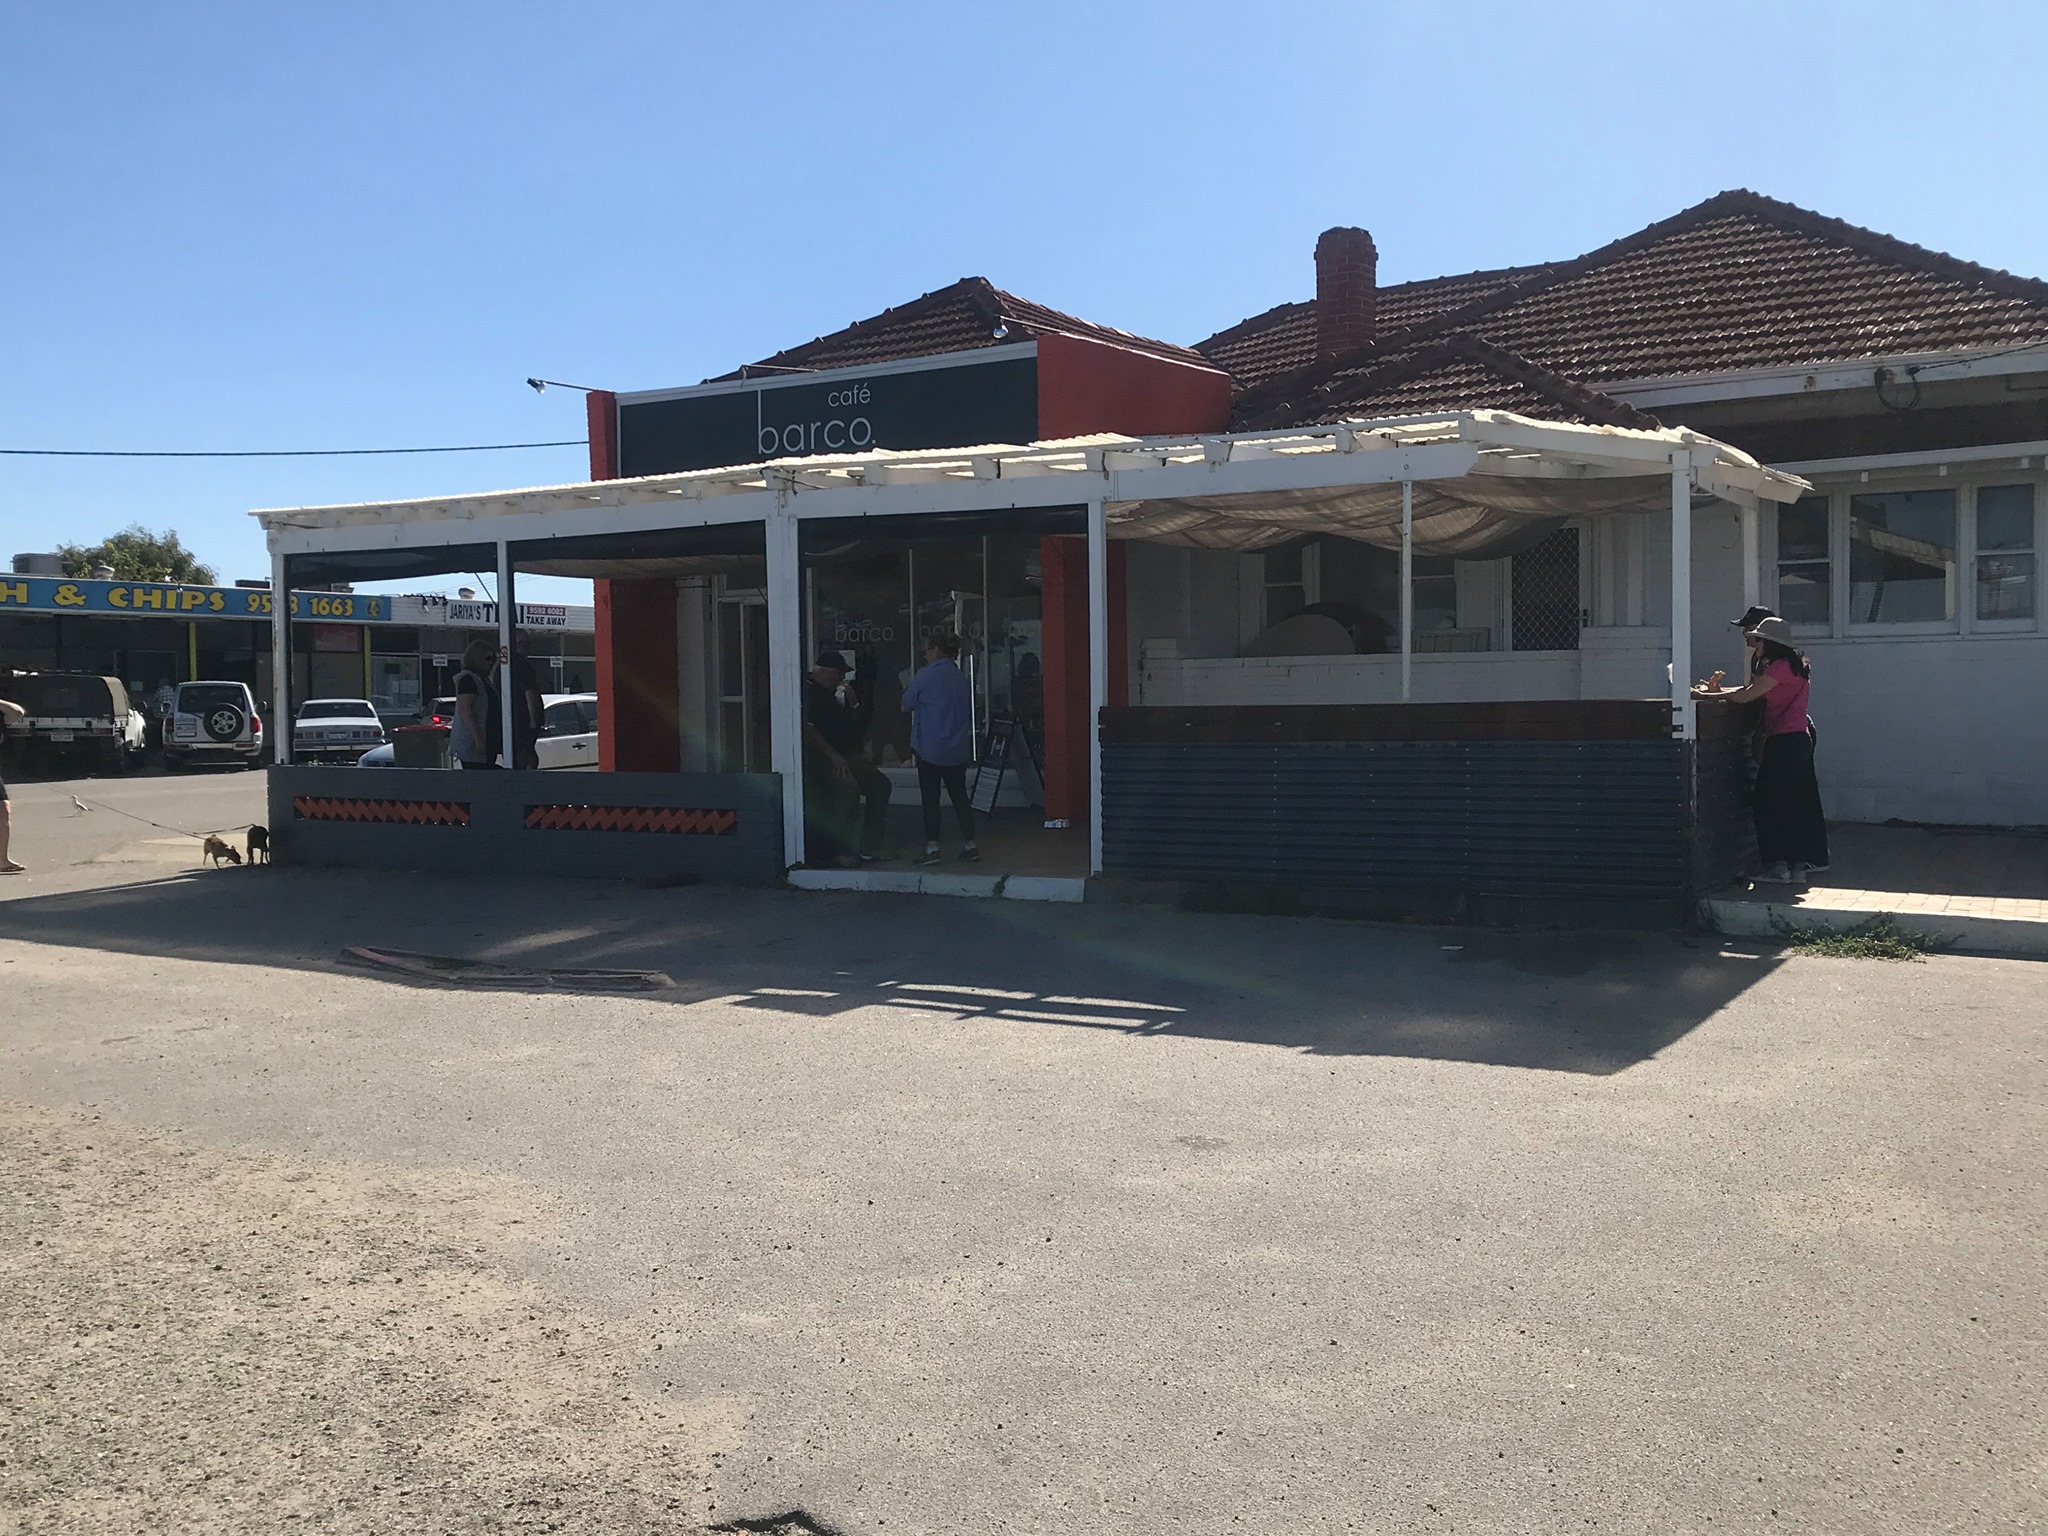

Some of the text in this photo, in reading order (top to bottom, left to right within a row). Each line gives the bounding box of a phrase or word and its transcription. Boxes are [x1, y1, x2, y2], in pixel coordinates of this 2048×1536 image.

[828, 382, 871, 408] café
[53, 583, 87, 607] &
[107, 586, 227, 612] CHIPS
[246, 593, 299, 613] 958
[309, 596, 353, 616] 1663
[450, 604, 481, 621] JARIYA'S
[526, 616, 566, 626] TAKE AWAY
[834, 609, 894, 642] barco
